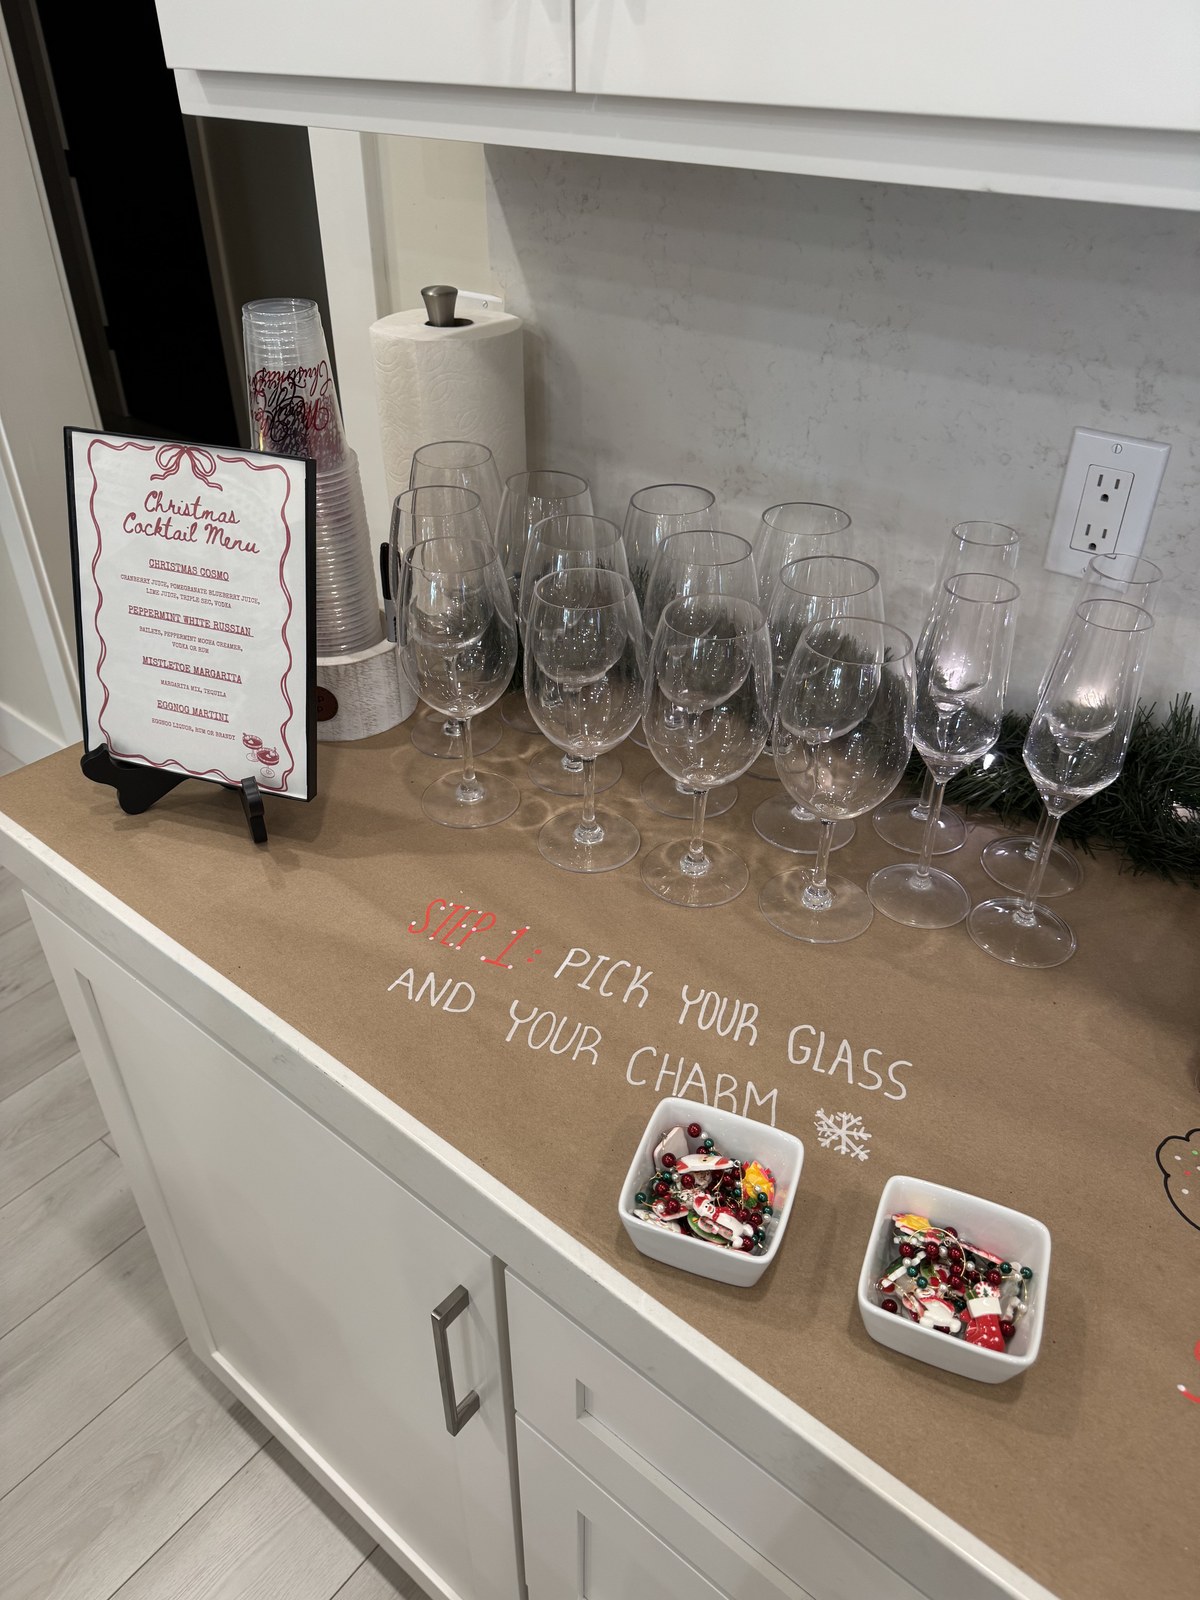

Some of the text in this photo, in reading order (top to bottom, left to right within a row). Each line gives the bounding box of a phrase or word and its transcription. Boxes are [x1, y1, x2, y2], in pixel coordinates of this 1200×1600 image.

[144, 490, 240, 524] Christmas
[123, 512, 260, 554] Cocktail Menu
[149, 558, 230, 581] CHRISTMAS COSMO
[120, 574, 261, 605] CRANBERRY JUICE, POMEGRANATE BLUEBERRY JUICE,
[146, 588, 232, 609] LIME JUICE, TRIPLE SEC, VODKA
[128, 605, 252, 637] PEPPERMINT WHITE RUSSIAN
[139, 626, 243, 652] BAILEYS, PEPPERMINT MOCHA CREAMER,
[171, 641, 209, 654] VODKA OR RUM
[142, 655, 243, 684] MISTLETOE MARGARITA
[160, 679, 227, 698] MARGARITA MIX, TEQUILA
[157, 699, 230, 723] EGGNOG MARTINI
[151, 717, 236, 741] EGGNOG LIQUOR, RUM OR BRANDY
[407, 898, 914, 1101] STEP 1: PICK YOUR GLASS
[387, 967, 779, 1127] AND YOUR CHARM
